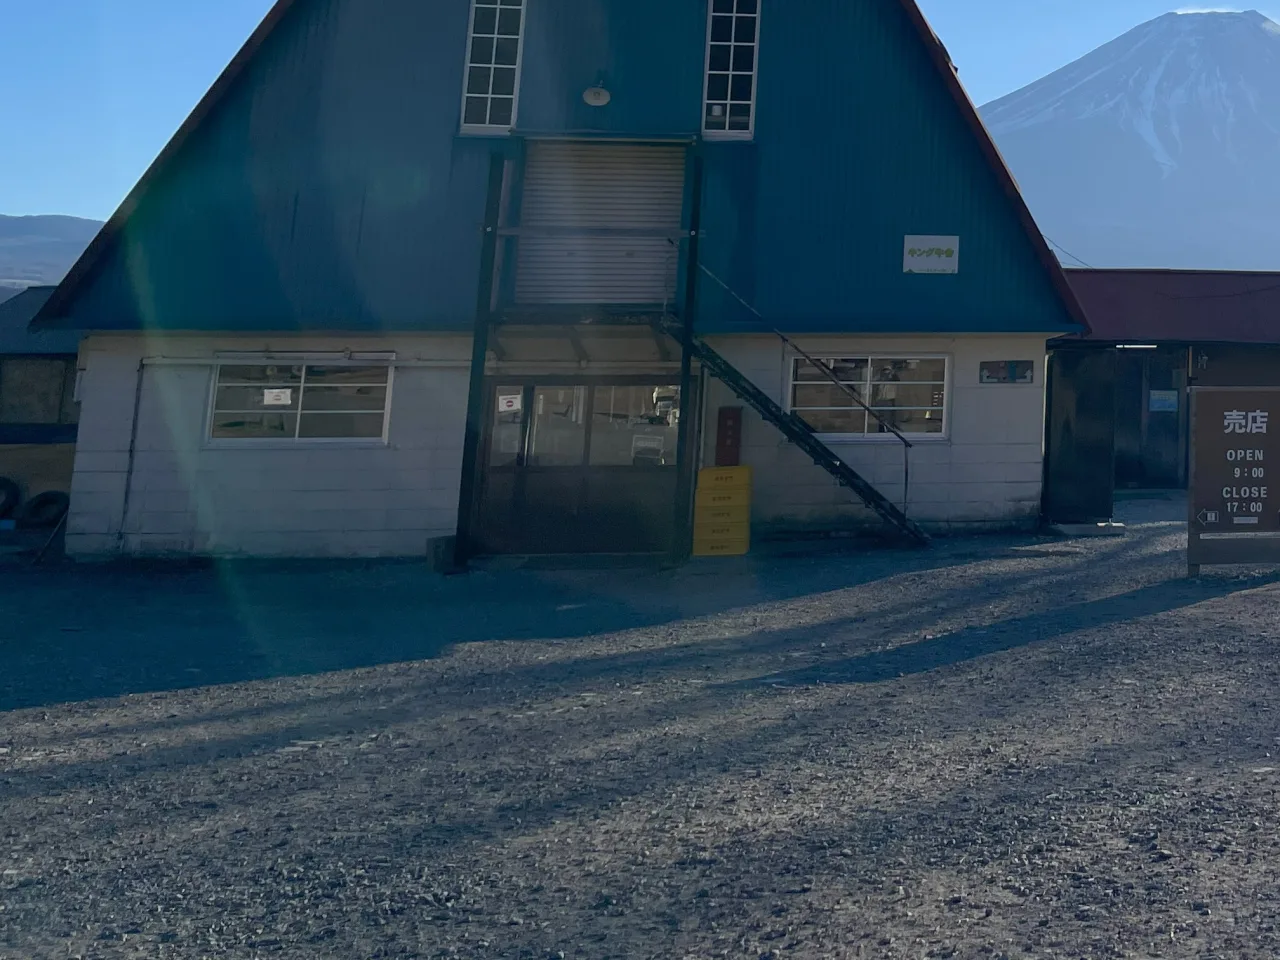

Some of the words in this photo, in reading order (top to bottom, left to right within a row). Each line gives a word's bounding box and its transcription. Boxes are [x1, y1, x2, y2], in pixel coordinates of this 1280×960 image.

[1223, 409, 1269, 434] 売店
[1226, 449, 1264, 461] OPEN
[1222, 486, 1268, 498] CLOSE
